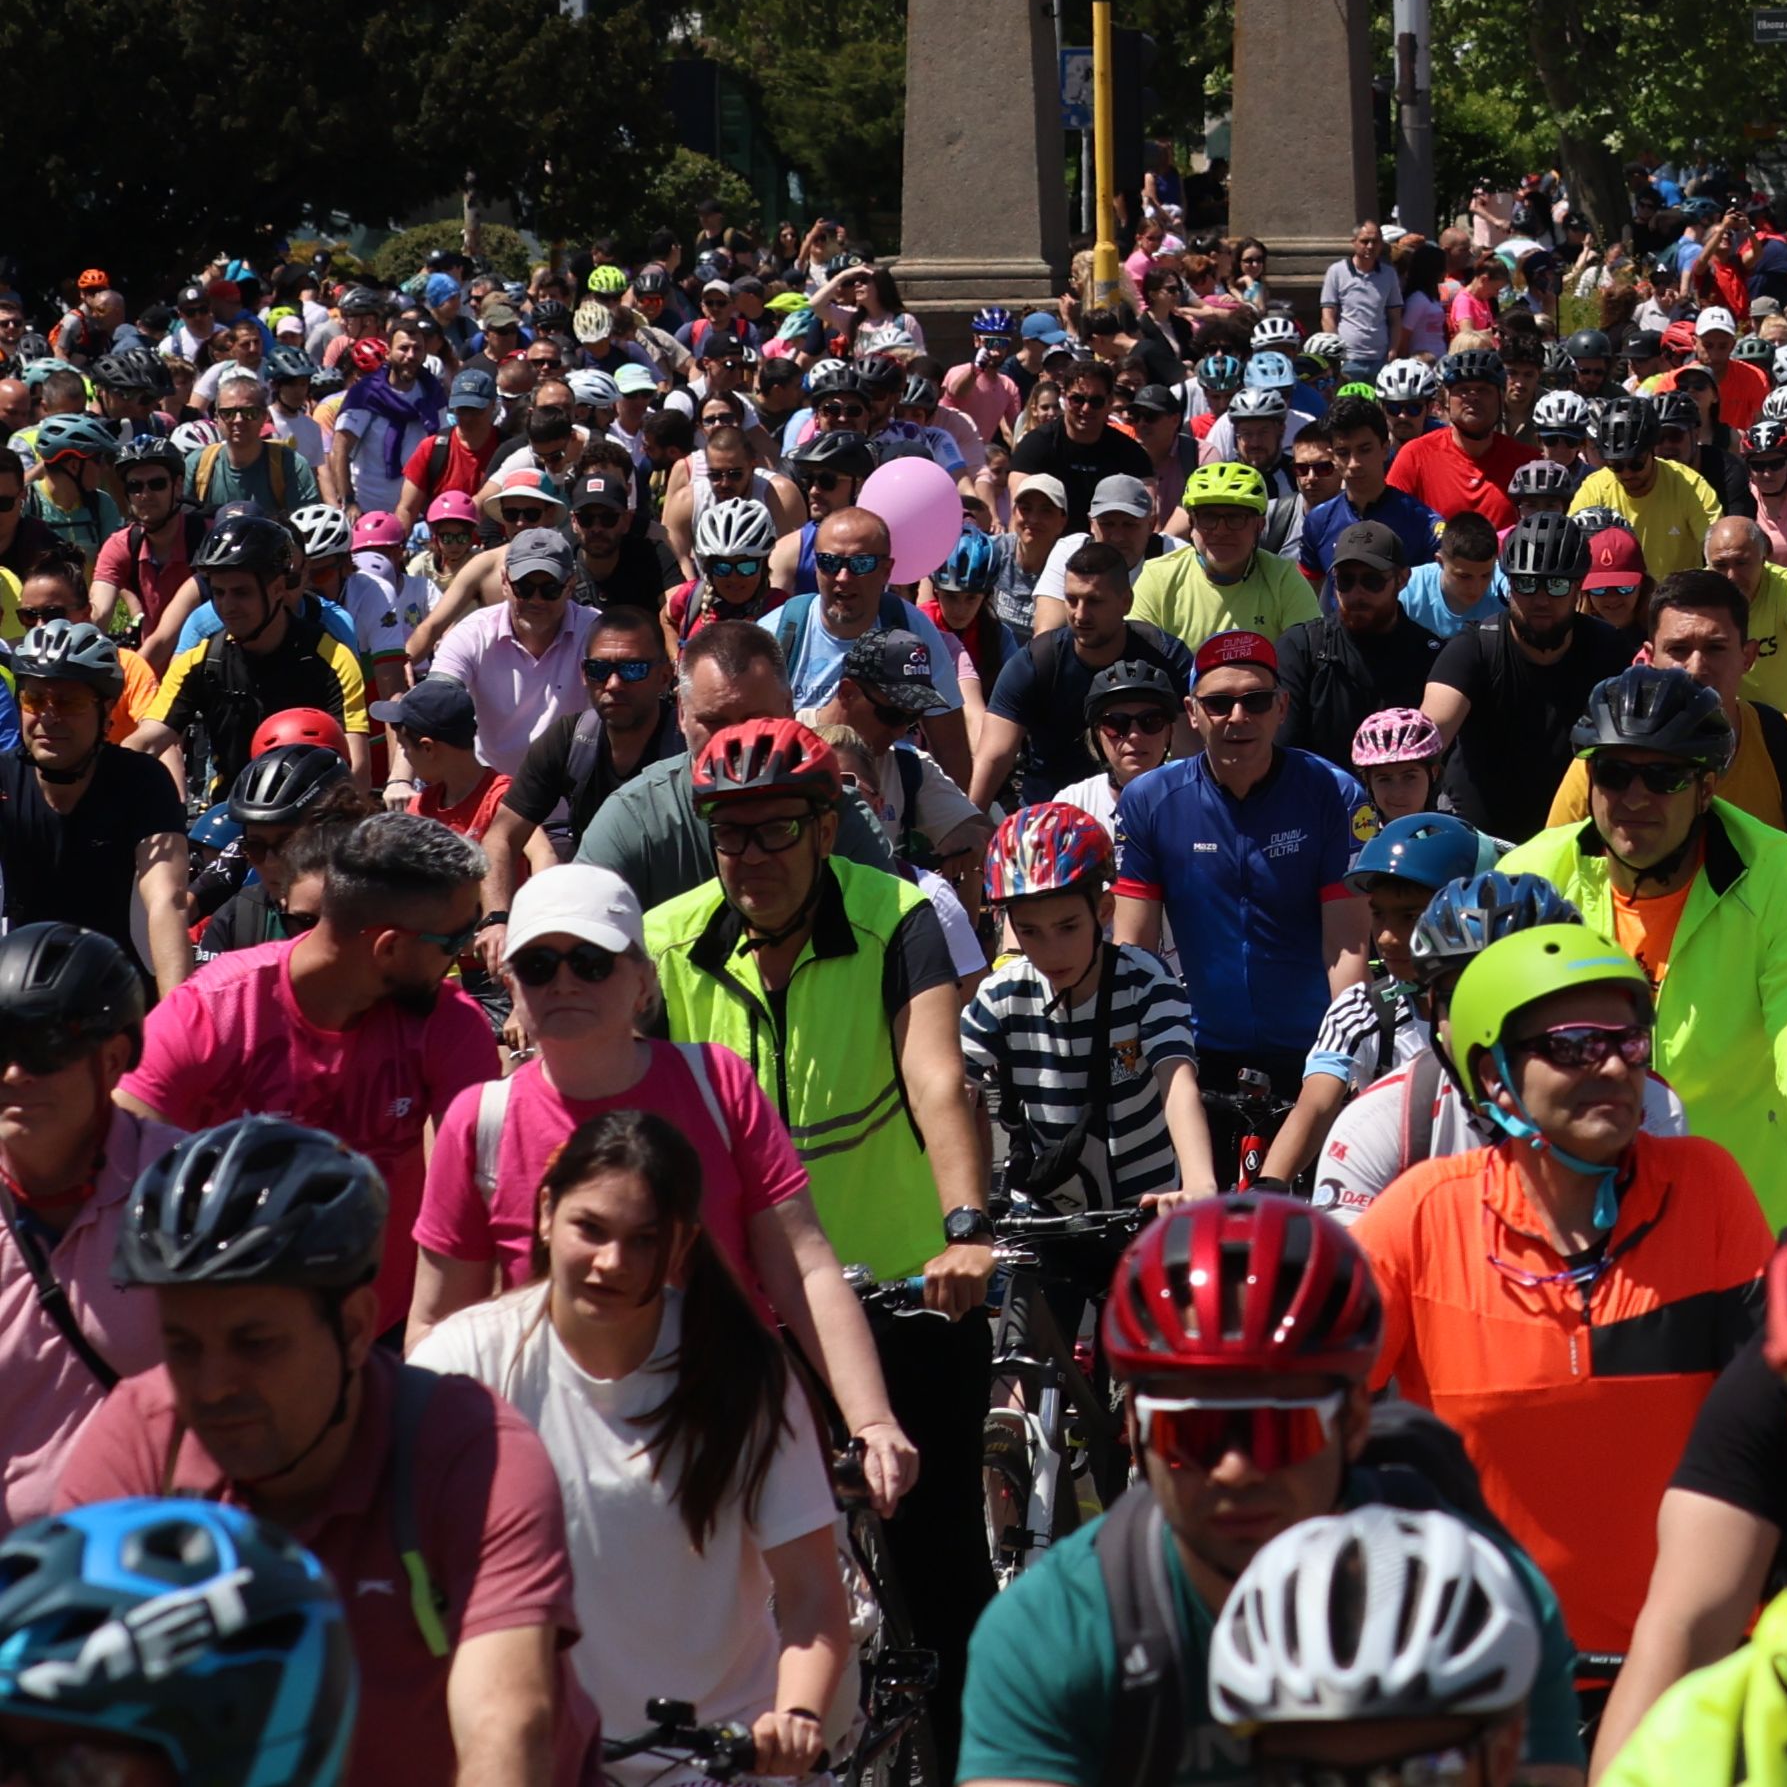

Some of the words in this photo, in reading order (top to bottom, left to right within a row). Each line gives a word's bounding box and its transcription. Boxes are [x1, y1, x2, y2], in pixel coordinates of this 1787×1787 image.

[1223, 635, 1254, 648] DUNAV
[1222, 648, 1252, 661] ULTRA
[1269, 828, 1302, 844] DUNAV
[1269, 842, 1300, 858] ULTRA
